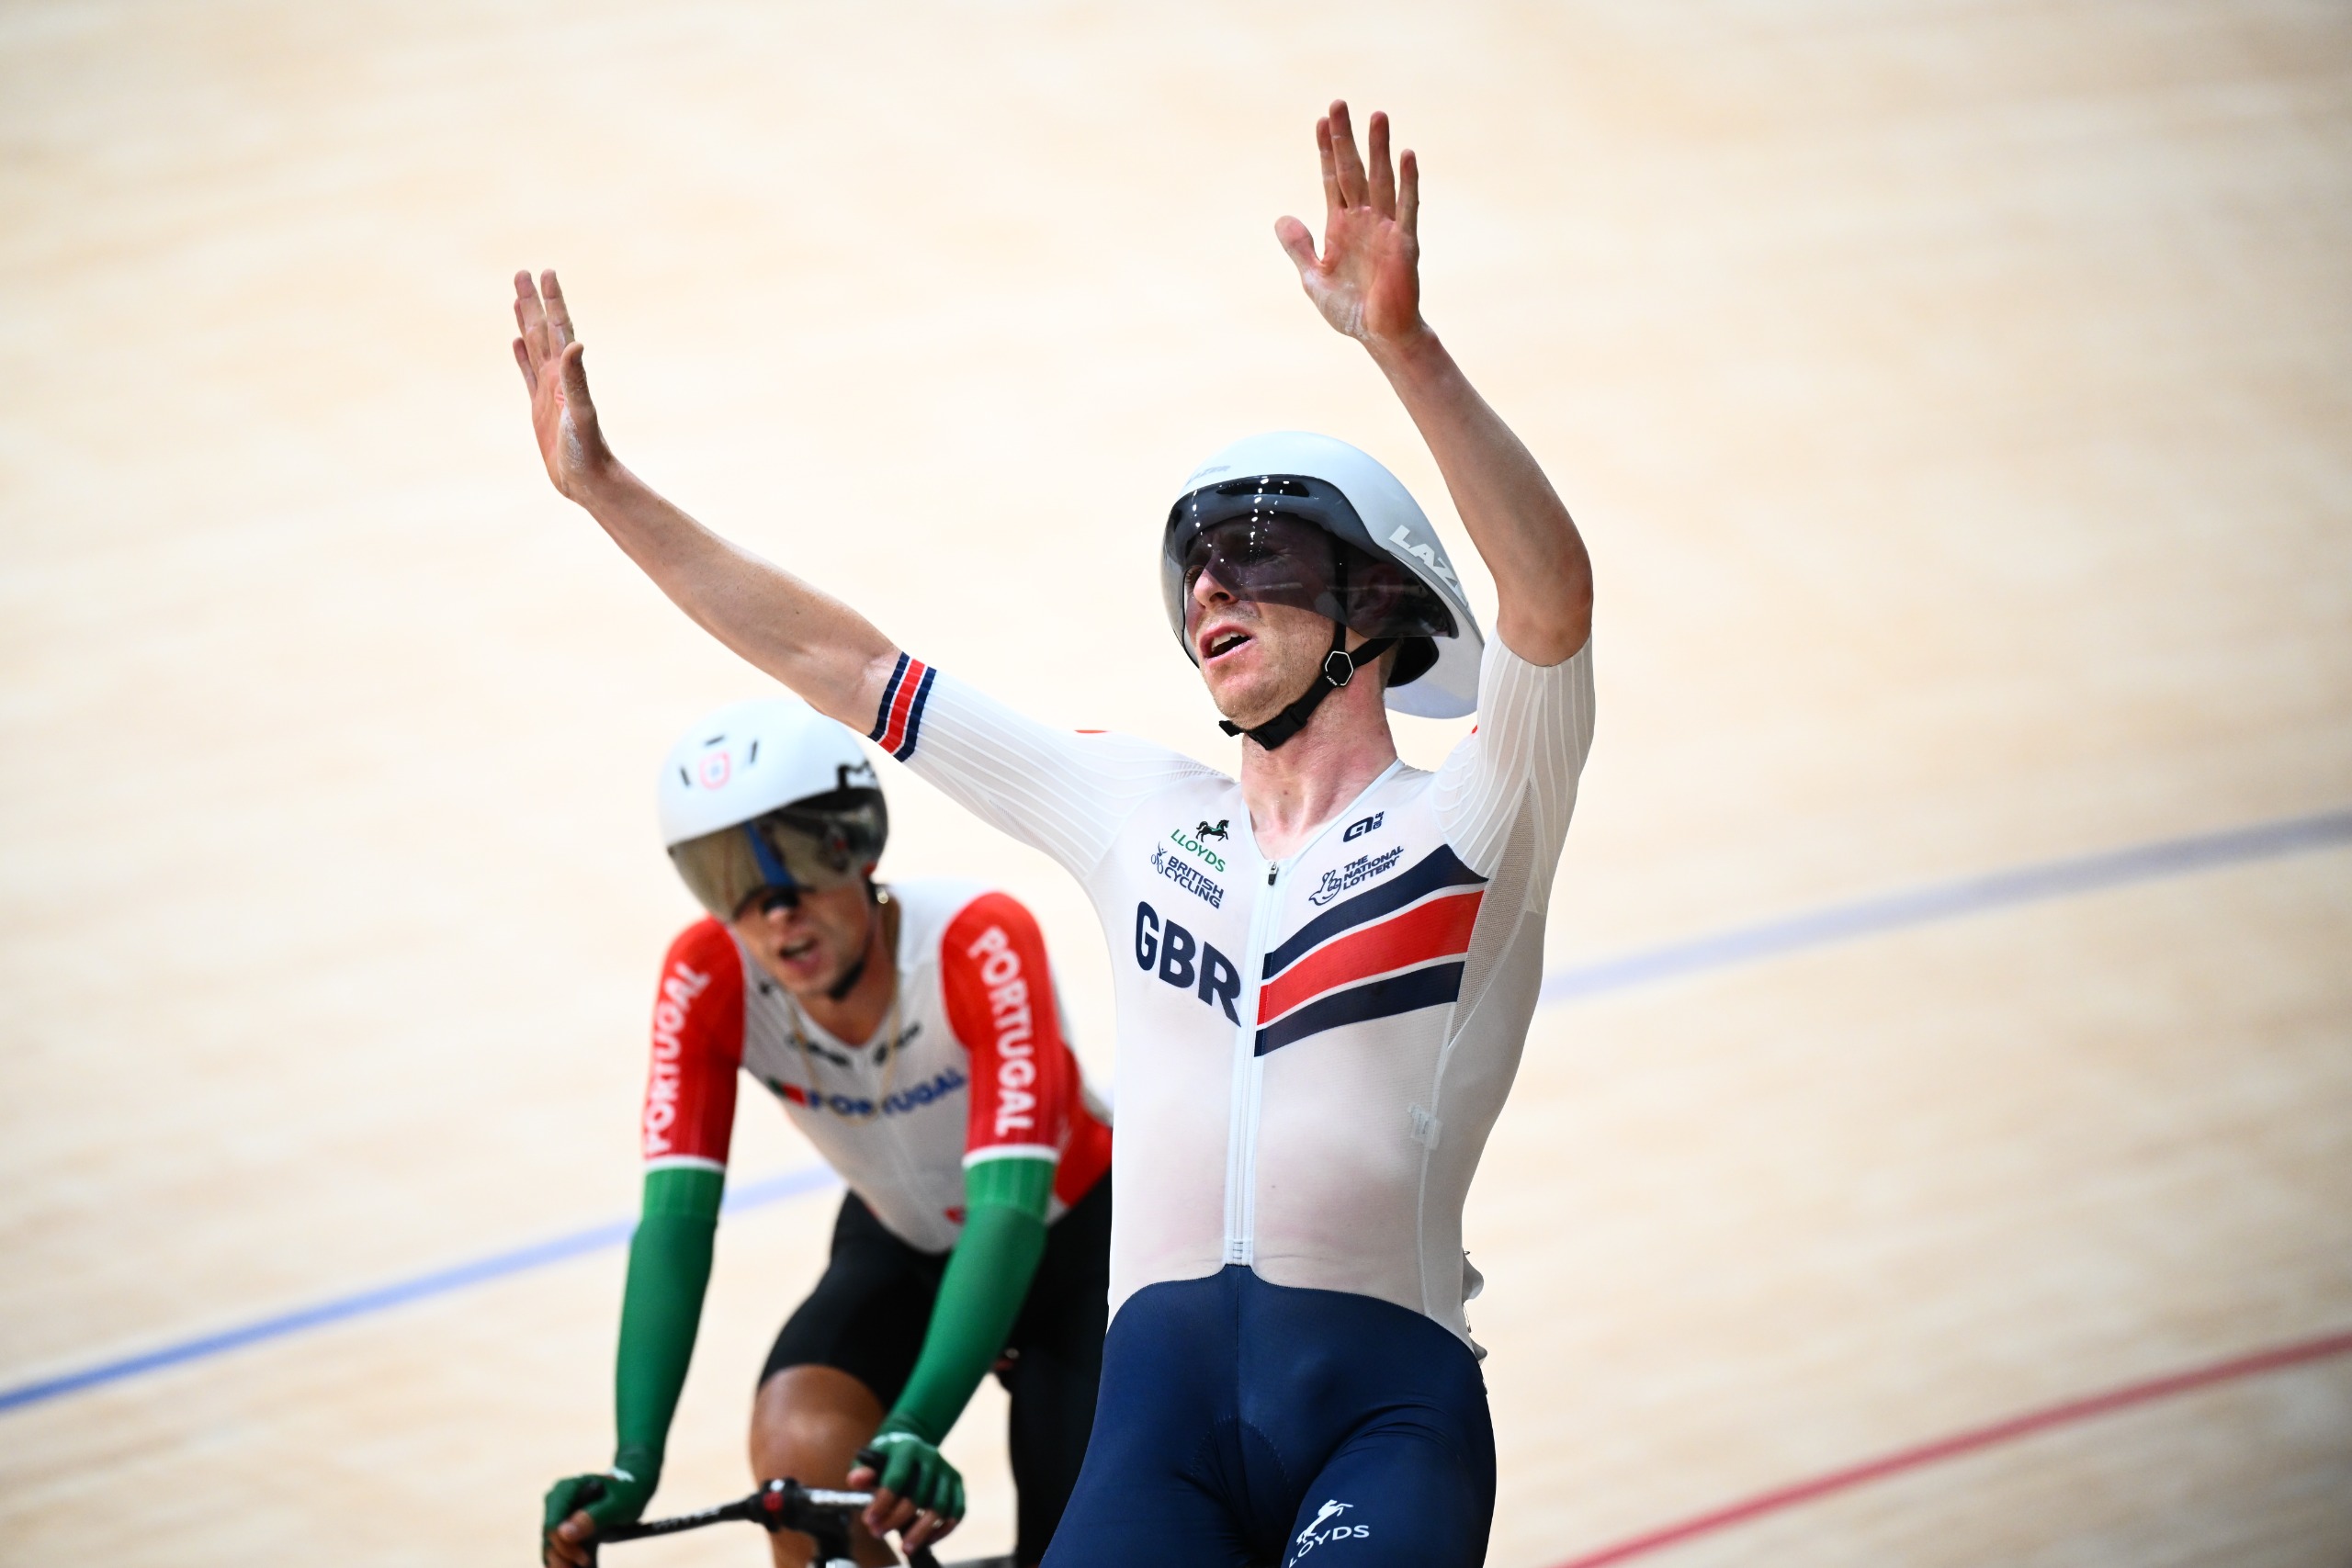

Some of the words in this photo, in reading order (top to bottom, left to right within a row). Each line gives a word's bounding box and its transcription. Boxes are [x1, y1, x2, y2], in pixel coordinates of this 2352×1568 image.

[1388, 525, 1474, 617] LAZ
[1170, 829, 1226, 873] LLOYDS
[1342, 856, 1400, 890] LOTTERY
[1343, 854, 1369, 872] THE
[1343, 846, 1405, 882] NATIONAL
[1164, 866, 1221, 909] CYCLING
[1168, 855, 1225, 899] BRITISH
[1136, 901, 1241, 1028] GBR
[967, 925, 1037, 1137] PORTUGAL
[643, 961, 712, 1159] PORTUGAL
[1288, 1525, 1370, 1568] LOYDS
